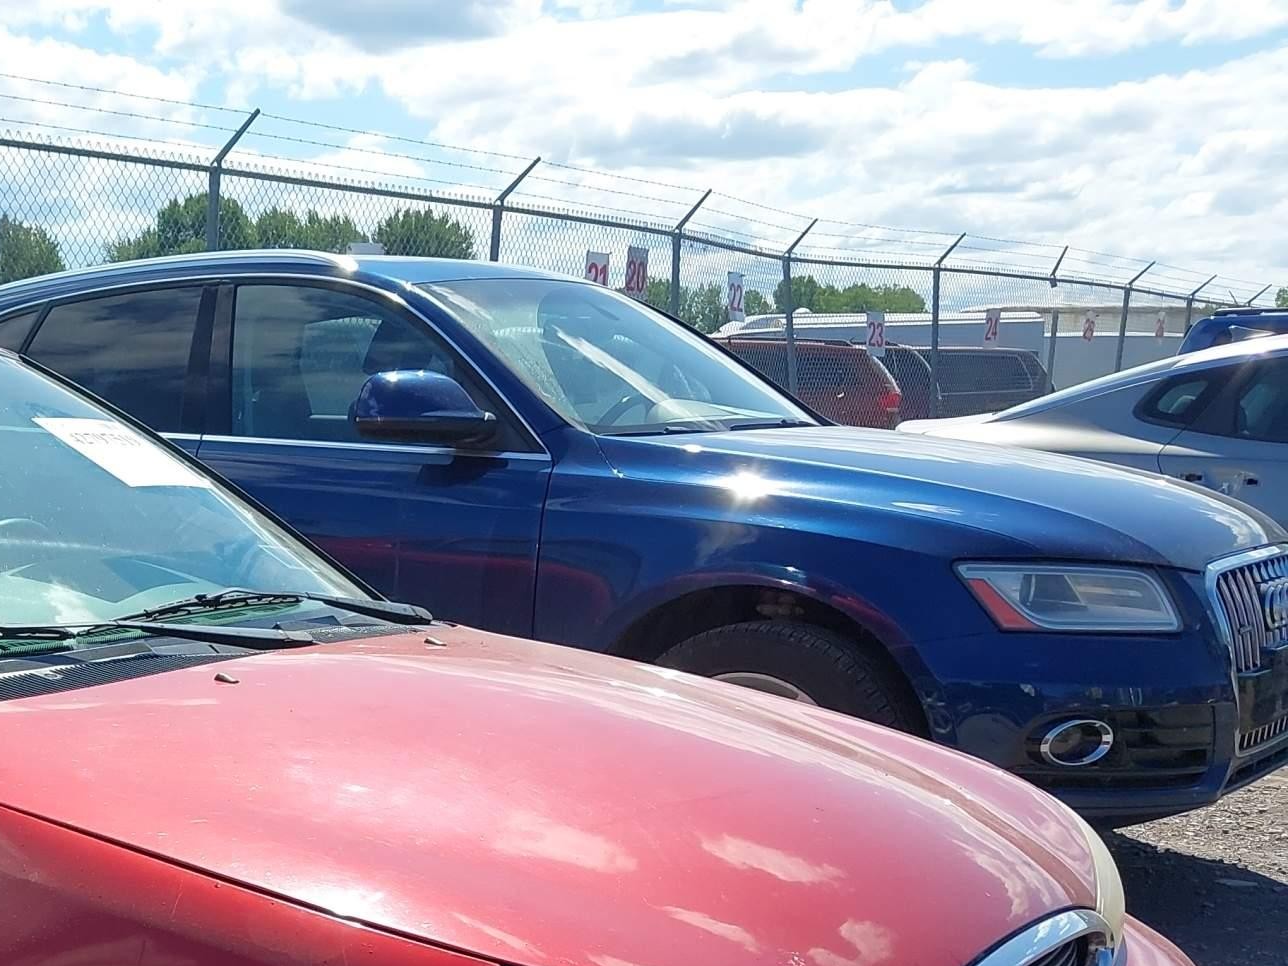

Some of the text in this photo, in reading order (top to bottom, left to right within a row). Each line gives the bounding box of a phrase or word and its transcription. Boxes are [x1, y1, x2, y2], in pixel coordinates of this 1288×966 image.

[588, 262, 607, 286] 21
[728, 282, 743, 312] 22
[868, 321, 884, 347] 23
[984, 317, 998, 341] 24
